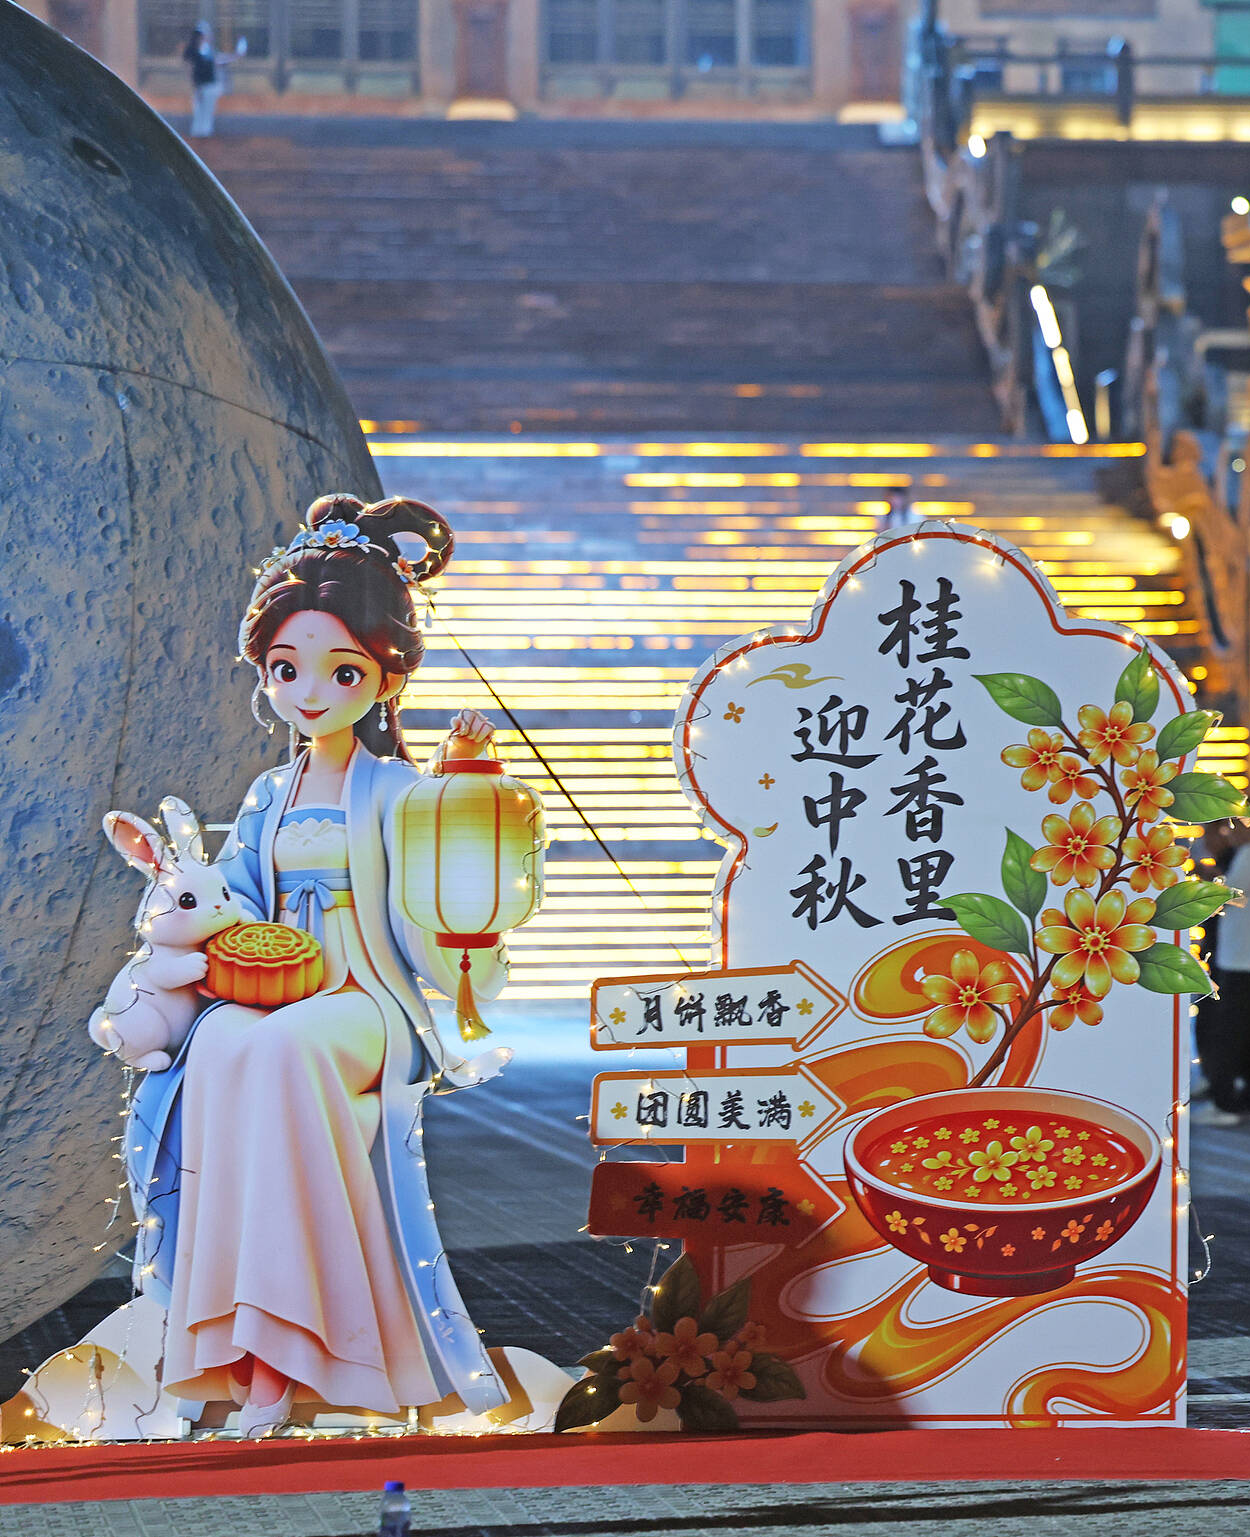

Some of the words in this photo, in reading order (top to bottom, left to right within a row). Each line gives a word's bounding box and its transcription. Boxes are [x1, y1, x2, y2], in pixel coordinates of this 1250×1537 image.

[878, 577, 970, 925] 桂花香里
[790, 695, 884, 930] 迎中秋
[636, 989, 791, 1035] 月饼飘香
[636, 1090, 792, 1130] 团圆美满
[633, 1182, 791, 1226] 幸福安康
